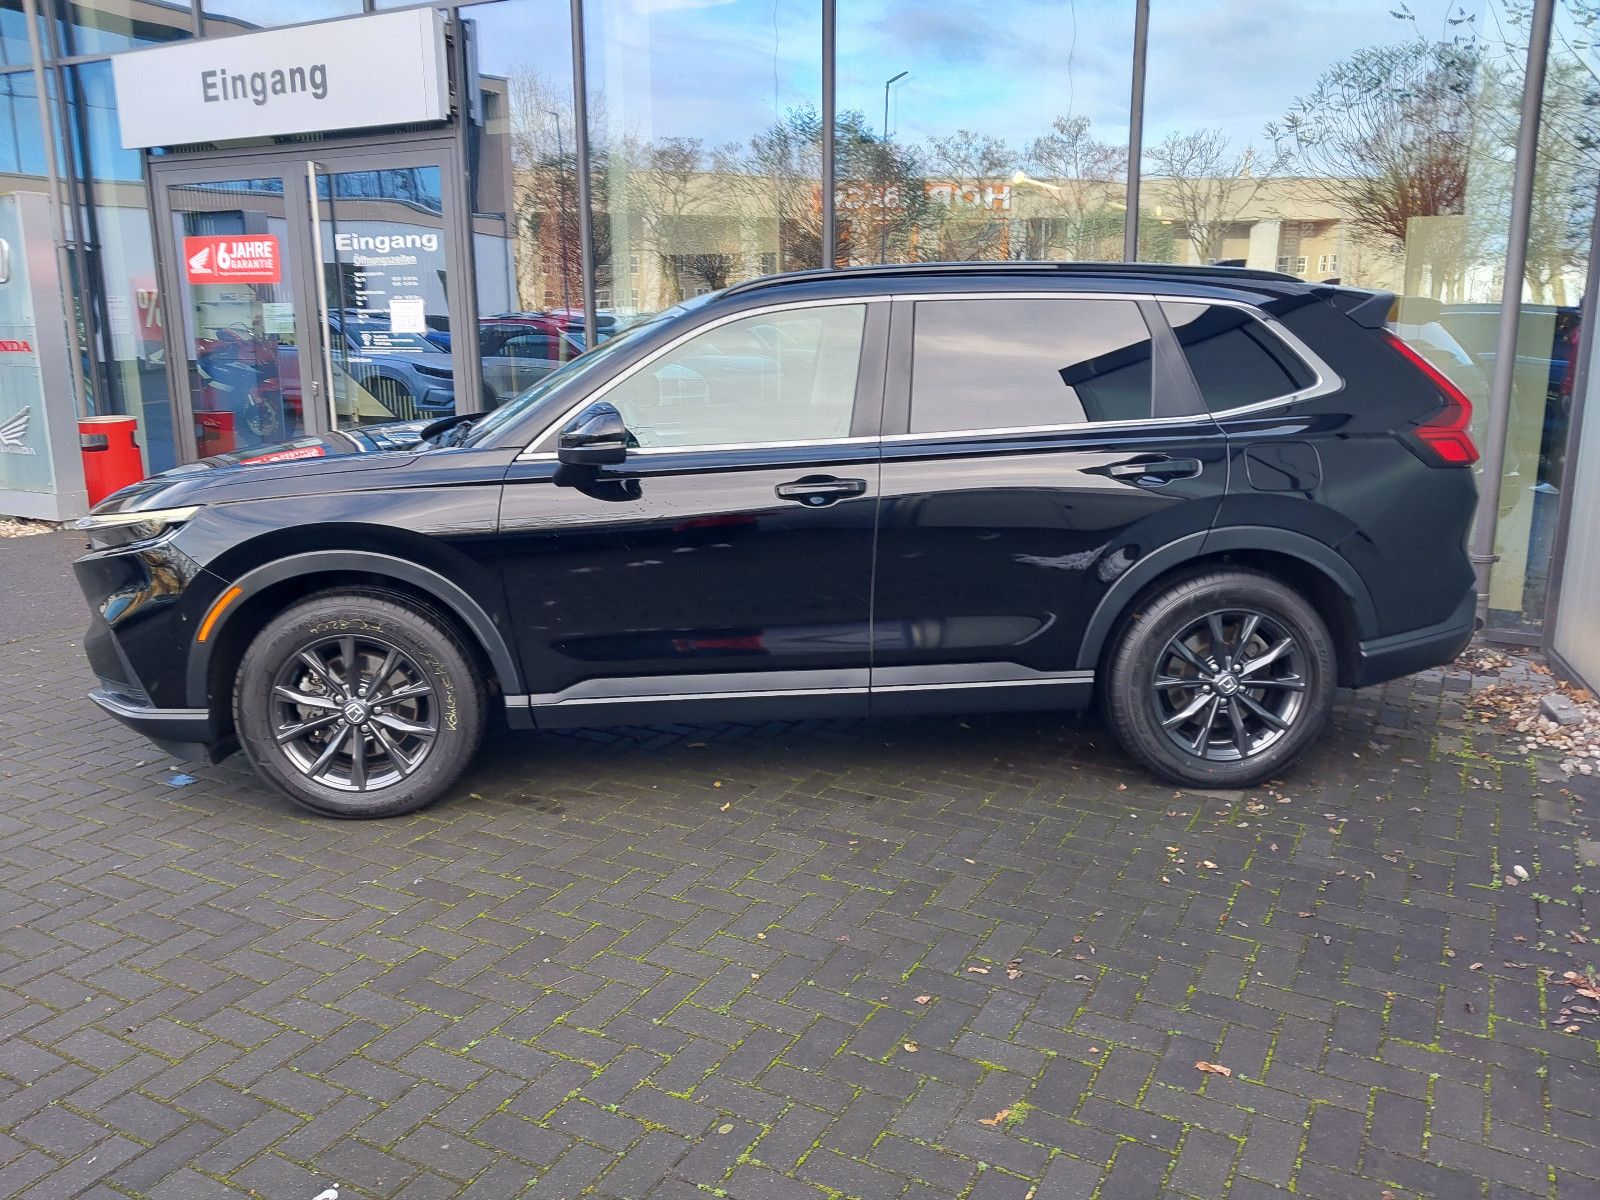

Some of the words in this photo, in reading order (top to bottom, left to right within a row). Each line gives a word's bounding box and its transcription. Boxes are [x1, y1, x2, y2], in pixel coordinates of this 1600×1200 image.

[201, 64, 328, 106] Eingang
[334, 232, 439, 253] Eingang
[217, 242, 231, 270] 6
[230, 241, 274, 258] JAHRE
[231, 258, 274, 269] GARANTIE
